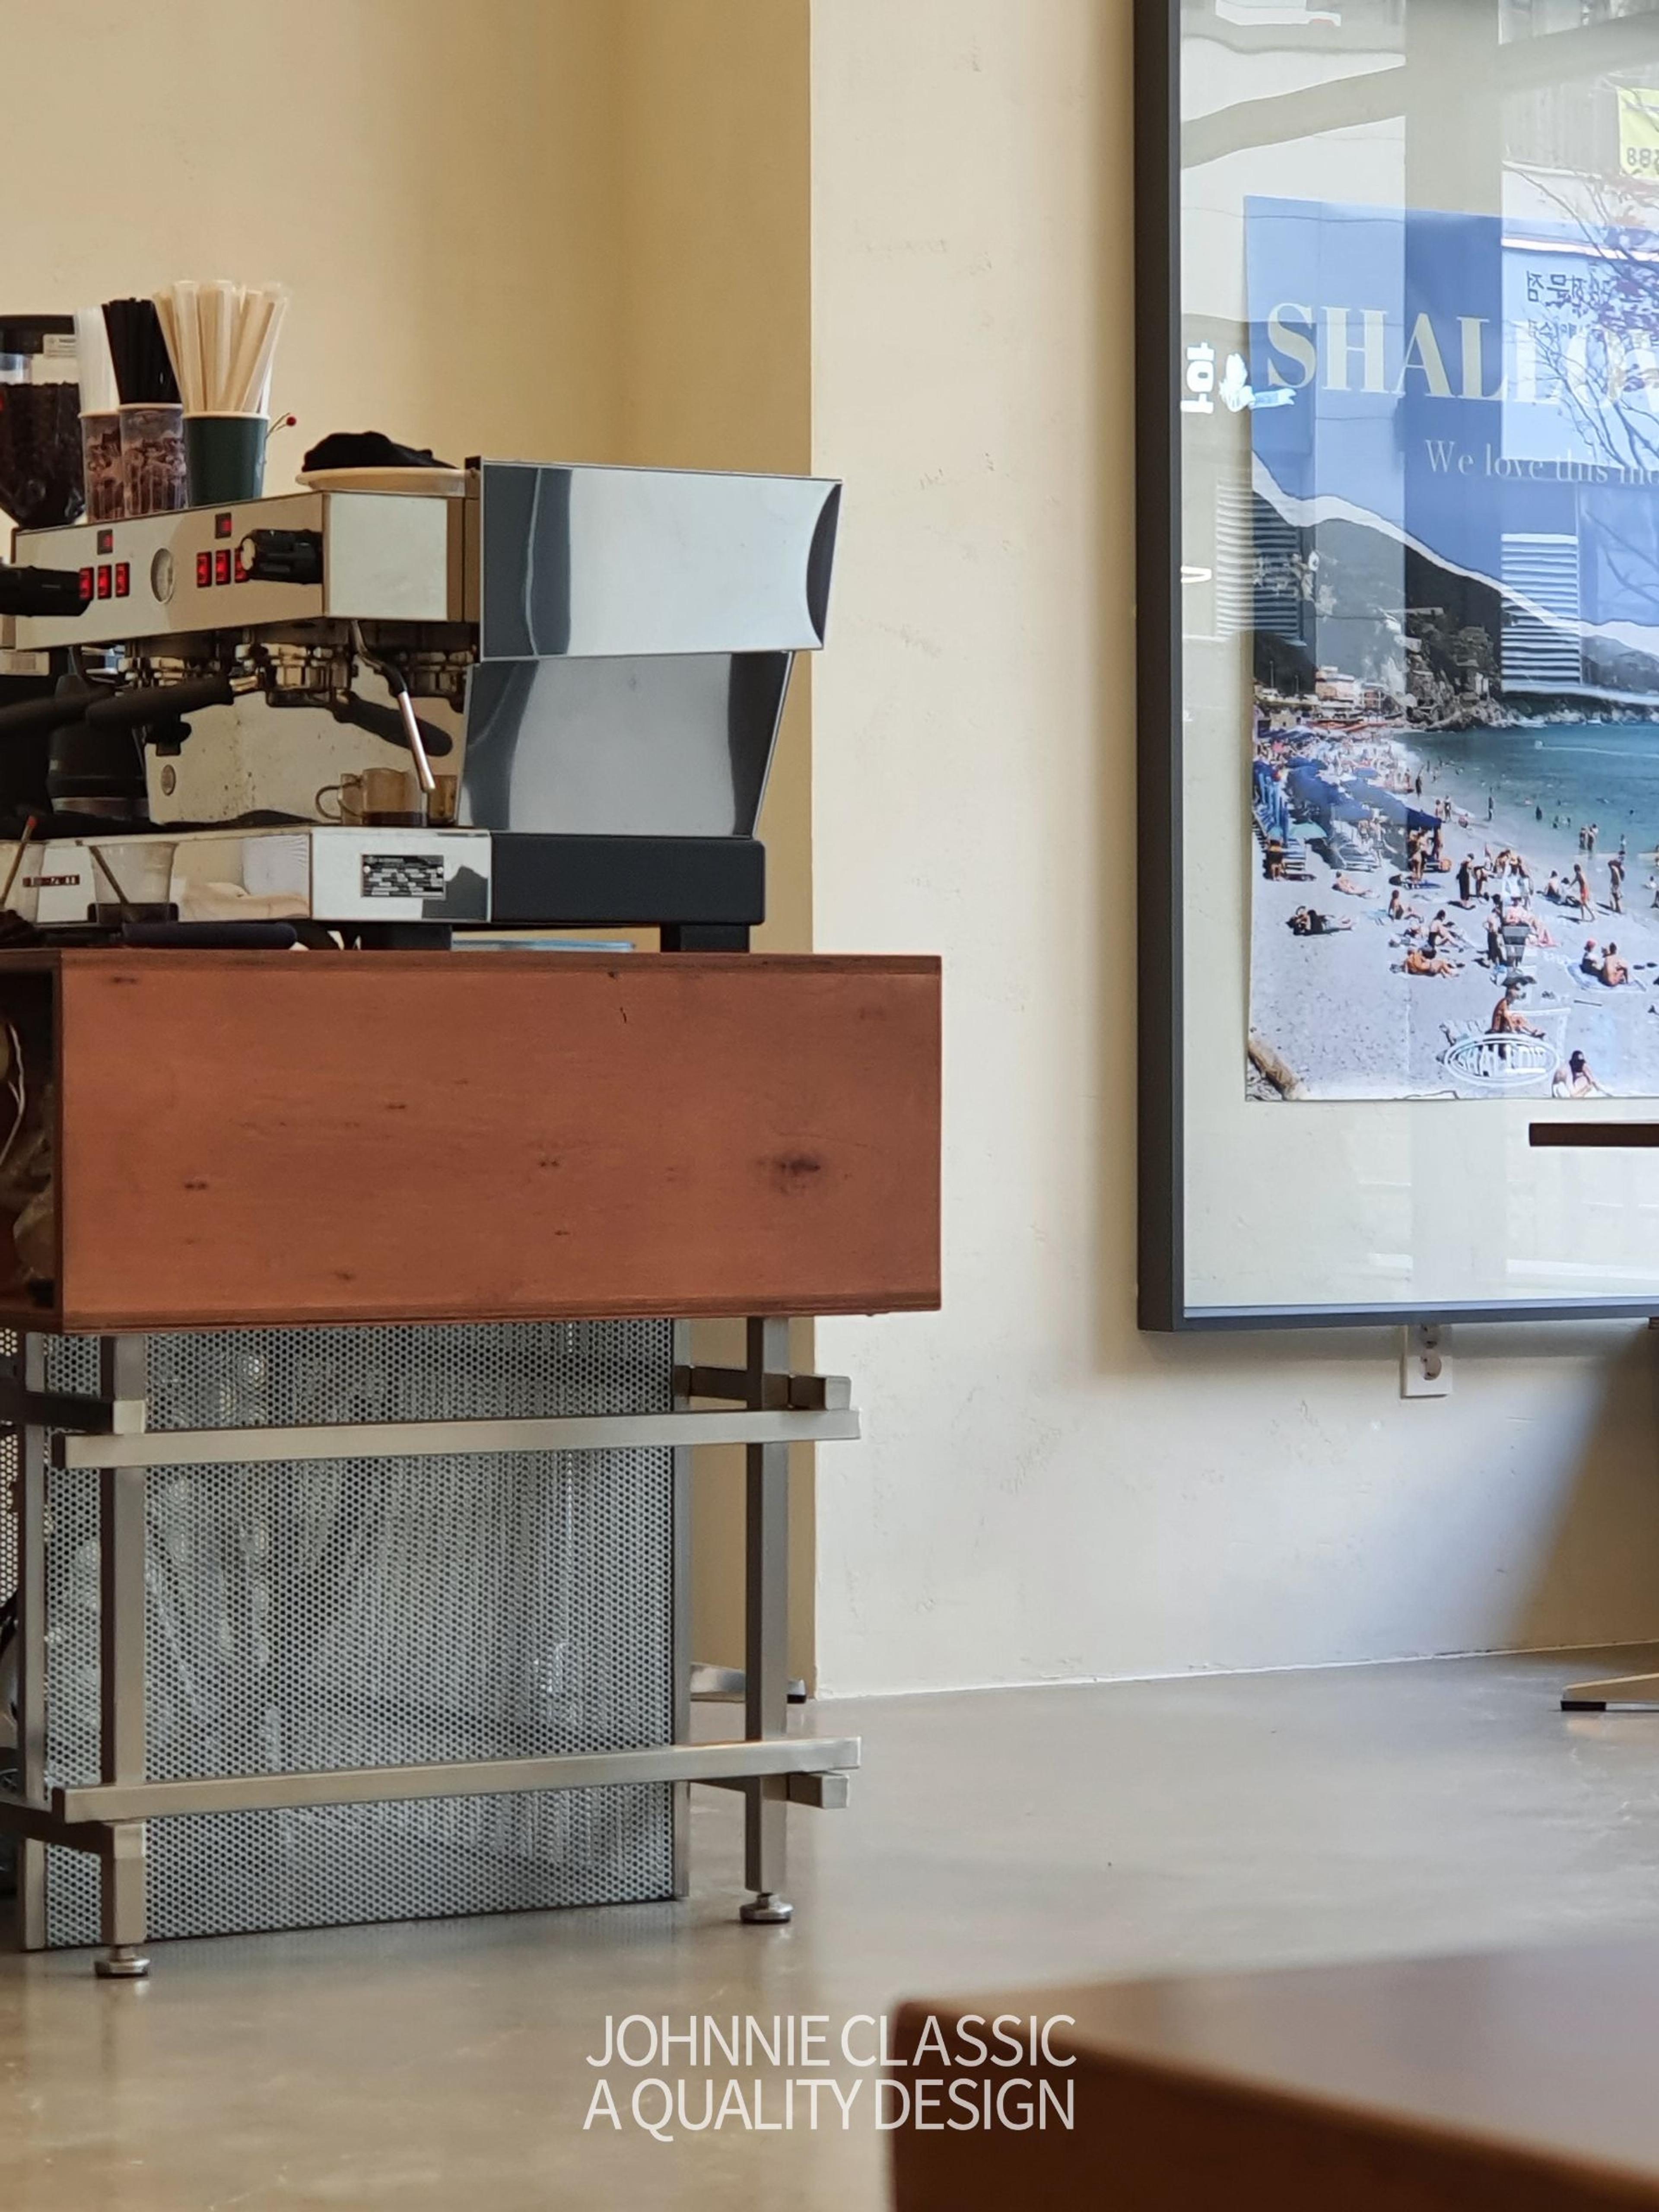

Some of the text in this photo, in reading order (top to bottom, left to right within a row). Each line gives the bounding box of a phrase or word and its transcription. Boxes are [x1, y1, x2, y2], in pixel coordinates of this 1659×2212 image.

[1426, 439, 1474, 475] We
[1485, 443, 1543, 480] love
[1555, 448, 1608, 483] this
